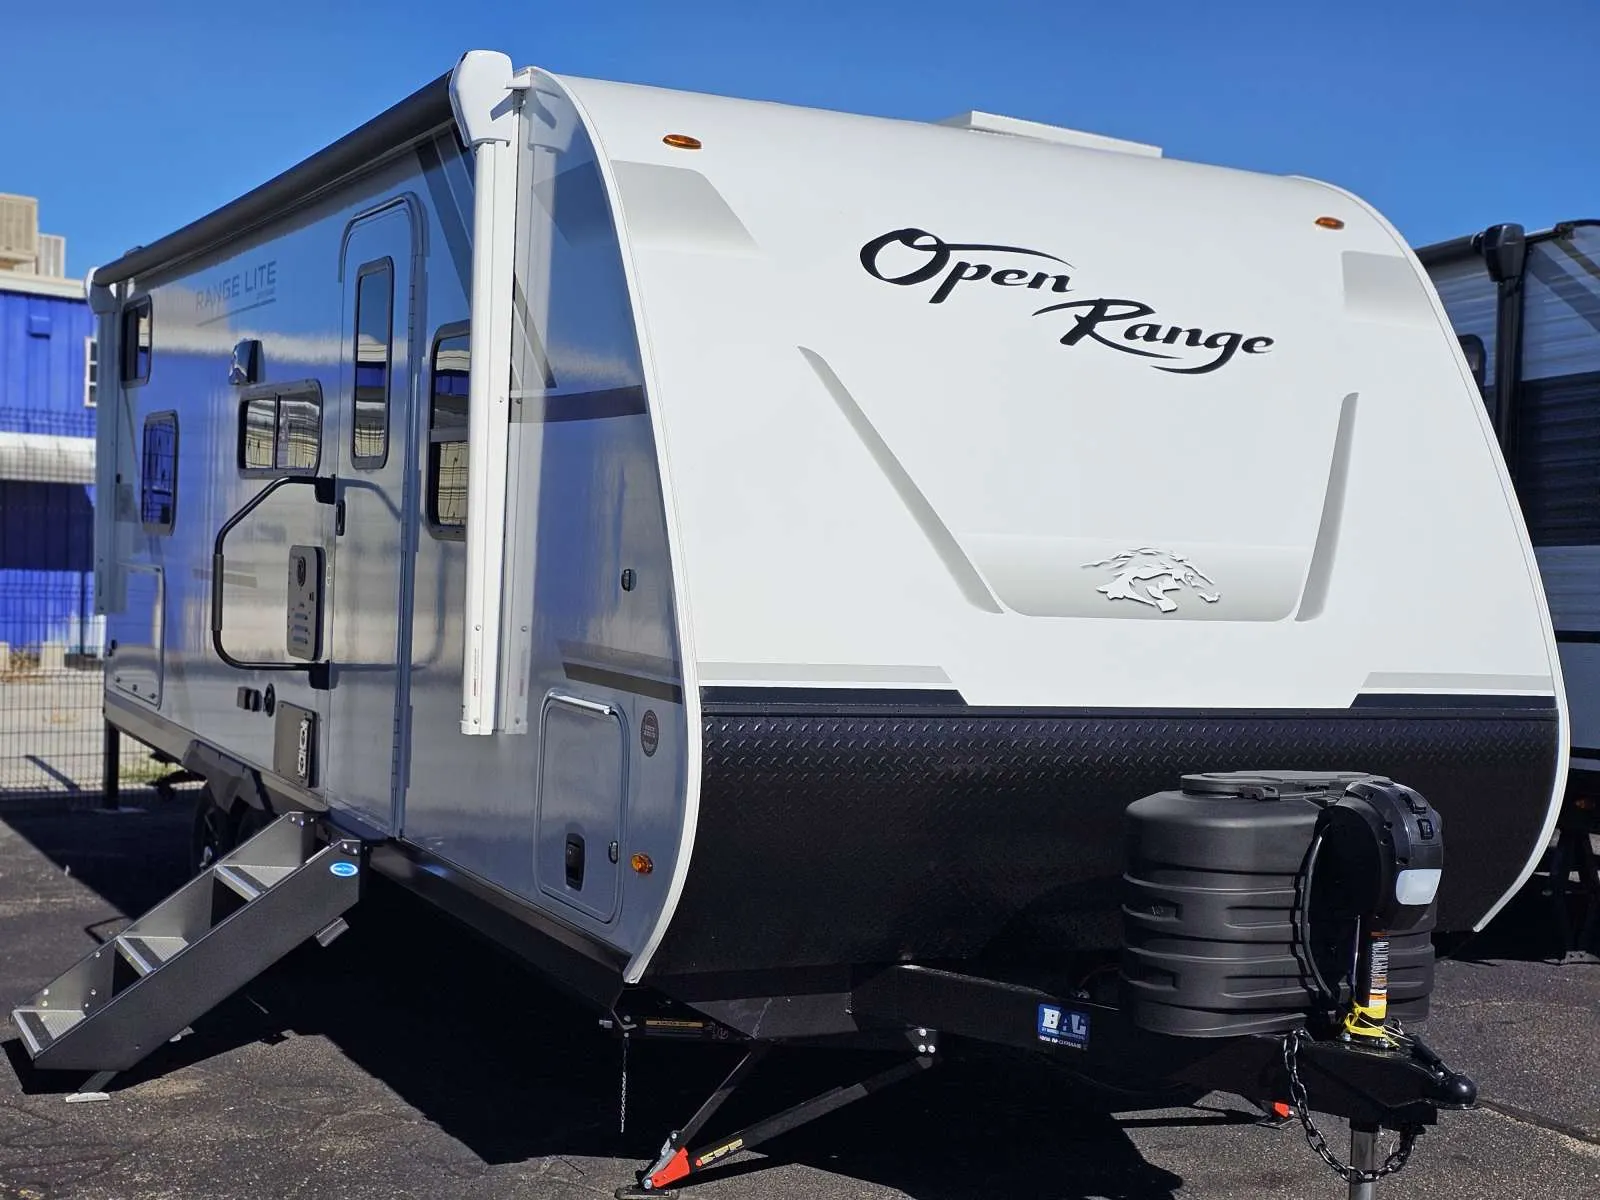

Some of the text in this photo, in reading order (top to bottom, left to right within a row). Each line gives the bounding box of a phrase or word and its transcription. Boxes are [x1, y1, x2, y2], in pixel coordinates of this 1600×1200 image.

[196, 260, 276, 313] RANGE LITE
[860, 228, 1076, 304] Open
[1032, 298, 1275, 374] Range
